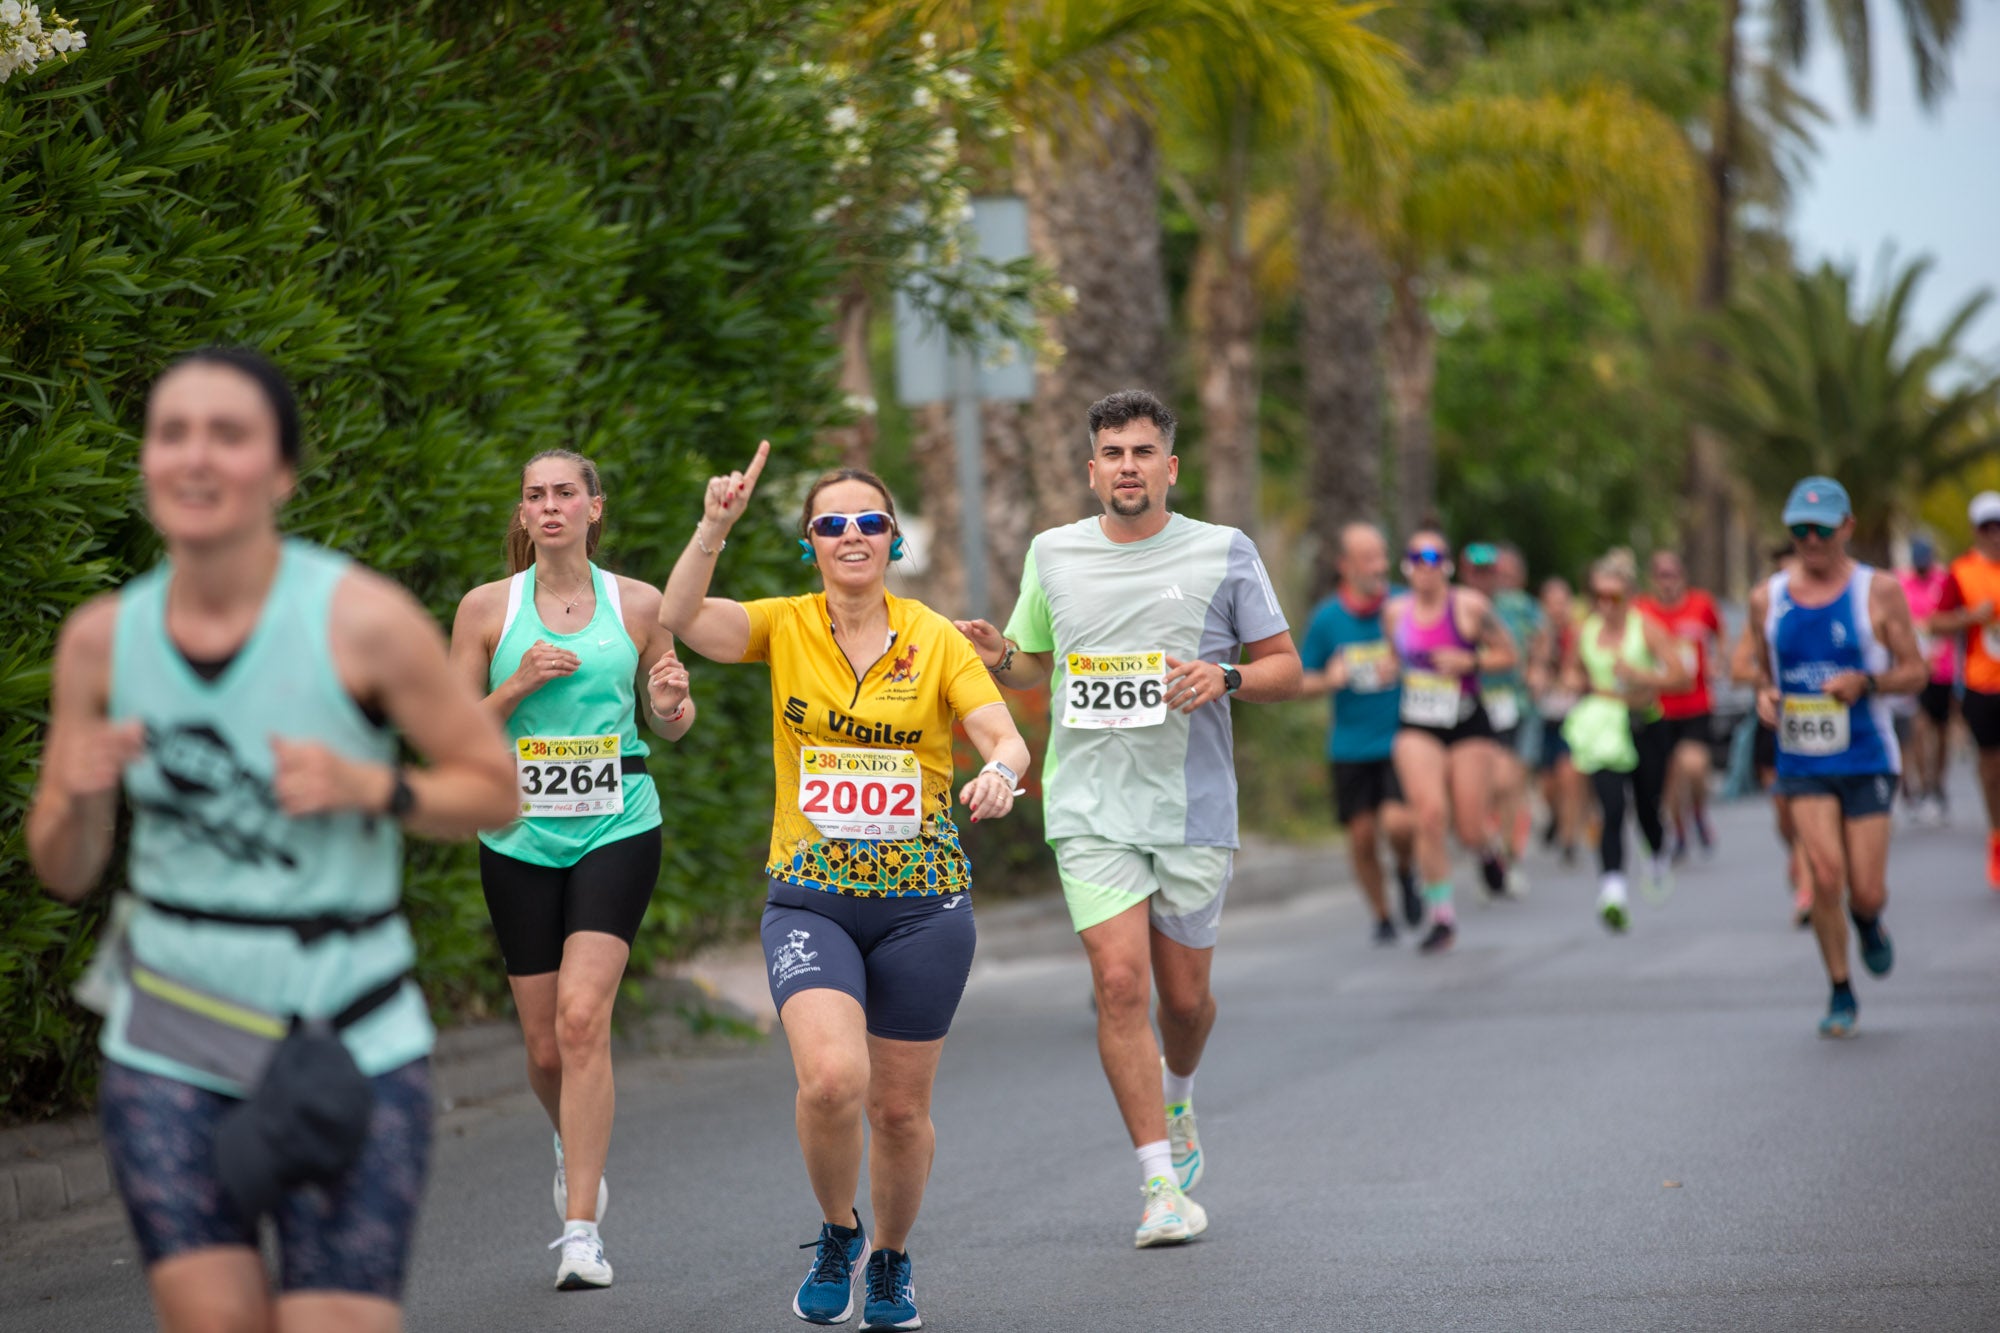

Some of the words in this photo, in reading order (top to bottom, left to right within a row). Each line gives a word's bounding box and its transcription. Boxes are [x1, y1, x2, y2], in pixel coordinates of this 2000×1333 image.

[1080, 657, 1091, 671] 38
[1091, 661, 1143, 672] FONDO
[1071, 680, 1162, 710] 3266
[829, 709, 923, 746] Vigilsa
[532, 742, 547, 755] 38
[546, 745, 599, 756] FONDO
[818, 753, 837, 768] 38
[837, 758, 897, 772] FONDO
[521, 763, 618, 795] 3264
[803, 780, 915, 816] 2002
